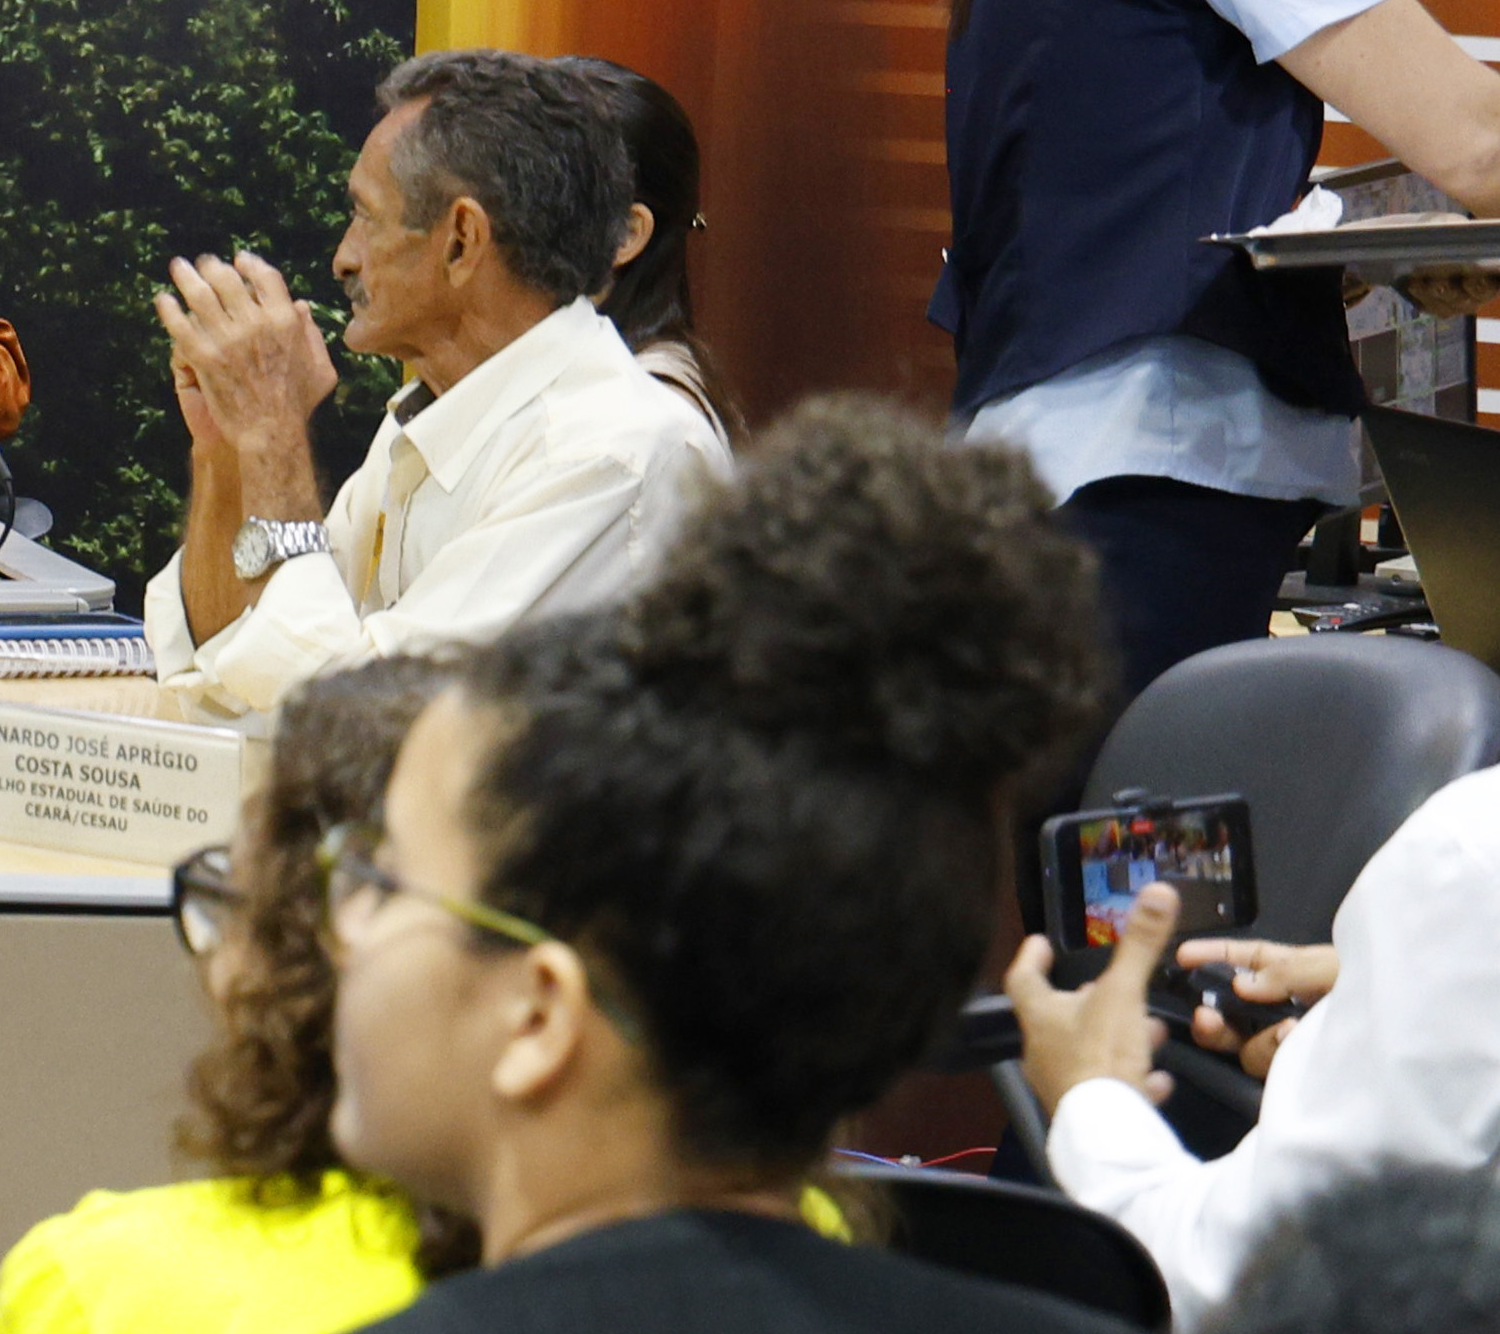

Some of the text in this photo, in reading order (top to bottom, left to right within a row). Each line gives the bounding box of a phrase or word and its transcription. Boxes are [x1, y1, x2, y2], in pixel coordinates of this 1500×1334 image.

[15, 754, 142, 792] COSTA SOUSA
[65, 735, 109, 759] JOSÉ
[116, 746, 198, 773] APRÍGIO
[24, 802, 128, 833] CEARÁ/CESAU
[31, 782, 105, 810] ESTADUAL
[109, 794, 127, 811] DE
[133, 798, 181, 821] SAÚDE
[187, 808, 209, 825] DO
